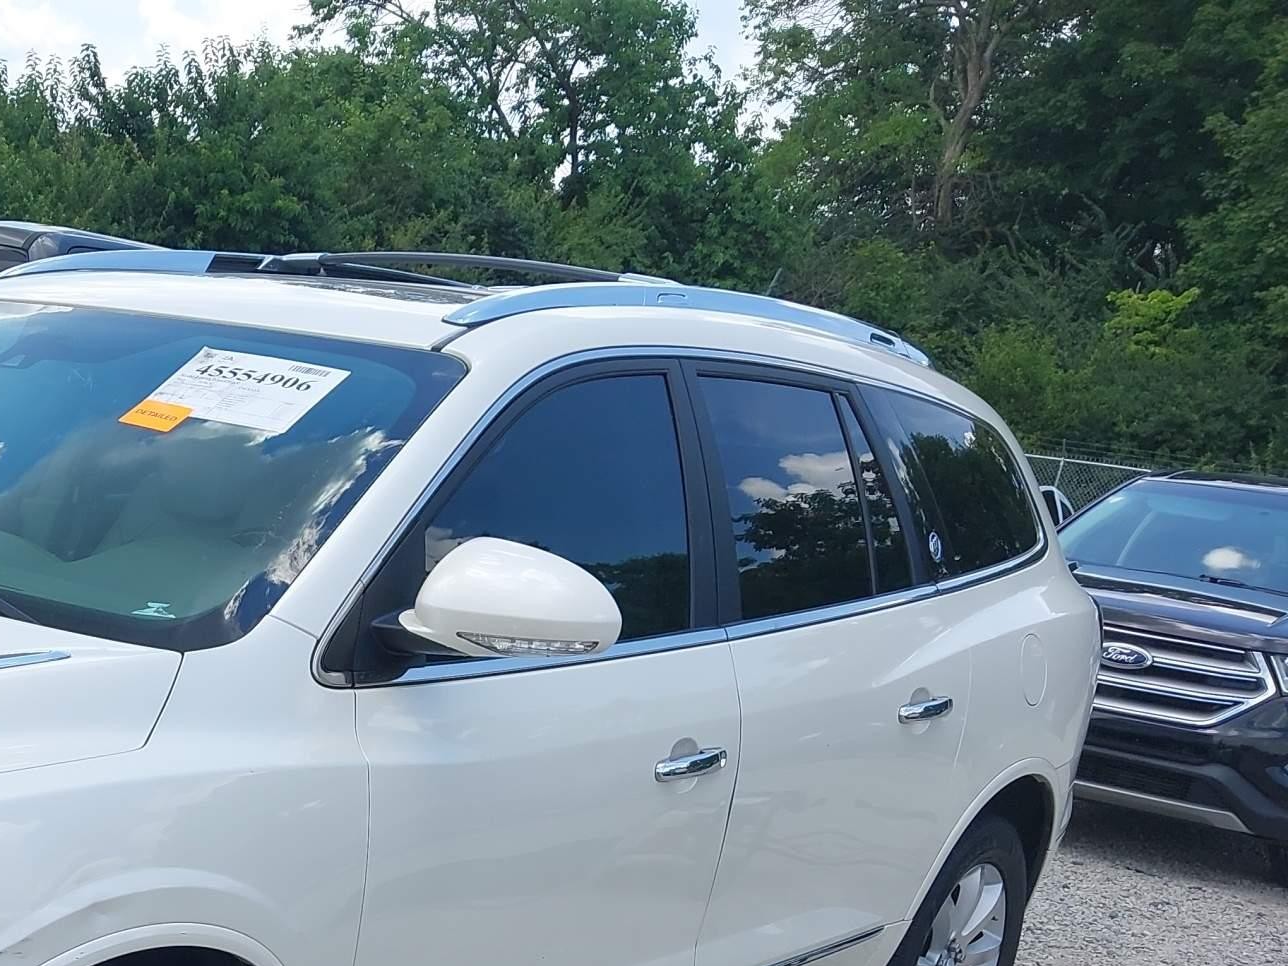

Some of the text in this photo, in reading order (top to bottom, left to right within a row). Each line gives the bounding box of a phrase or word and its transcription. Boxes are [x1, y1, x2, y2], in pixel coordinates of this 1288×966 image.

[196, 364, 318, 391] 45554906
[135, 408, 178, 422] DETAILED
[1102, 646, 1138, 663] Ford
